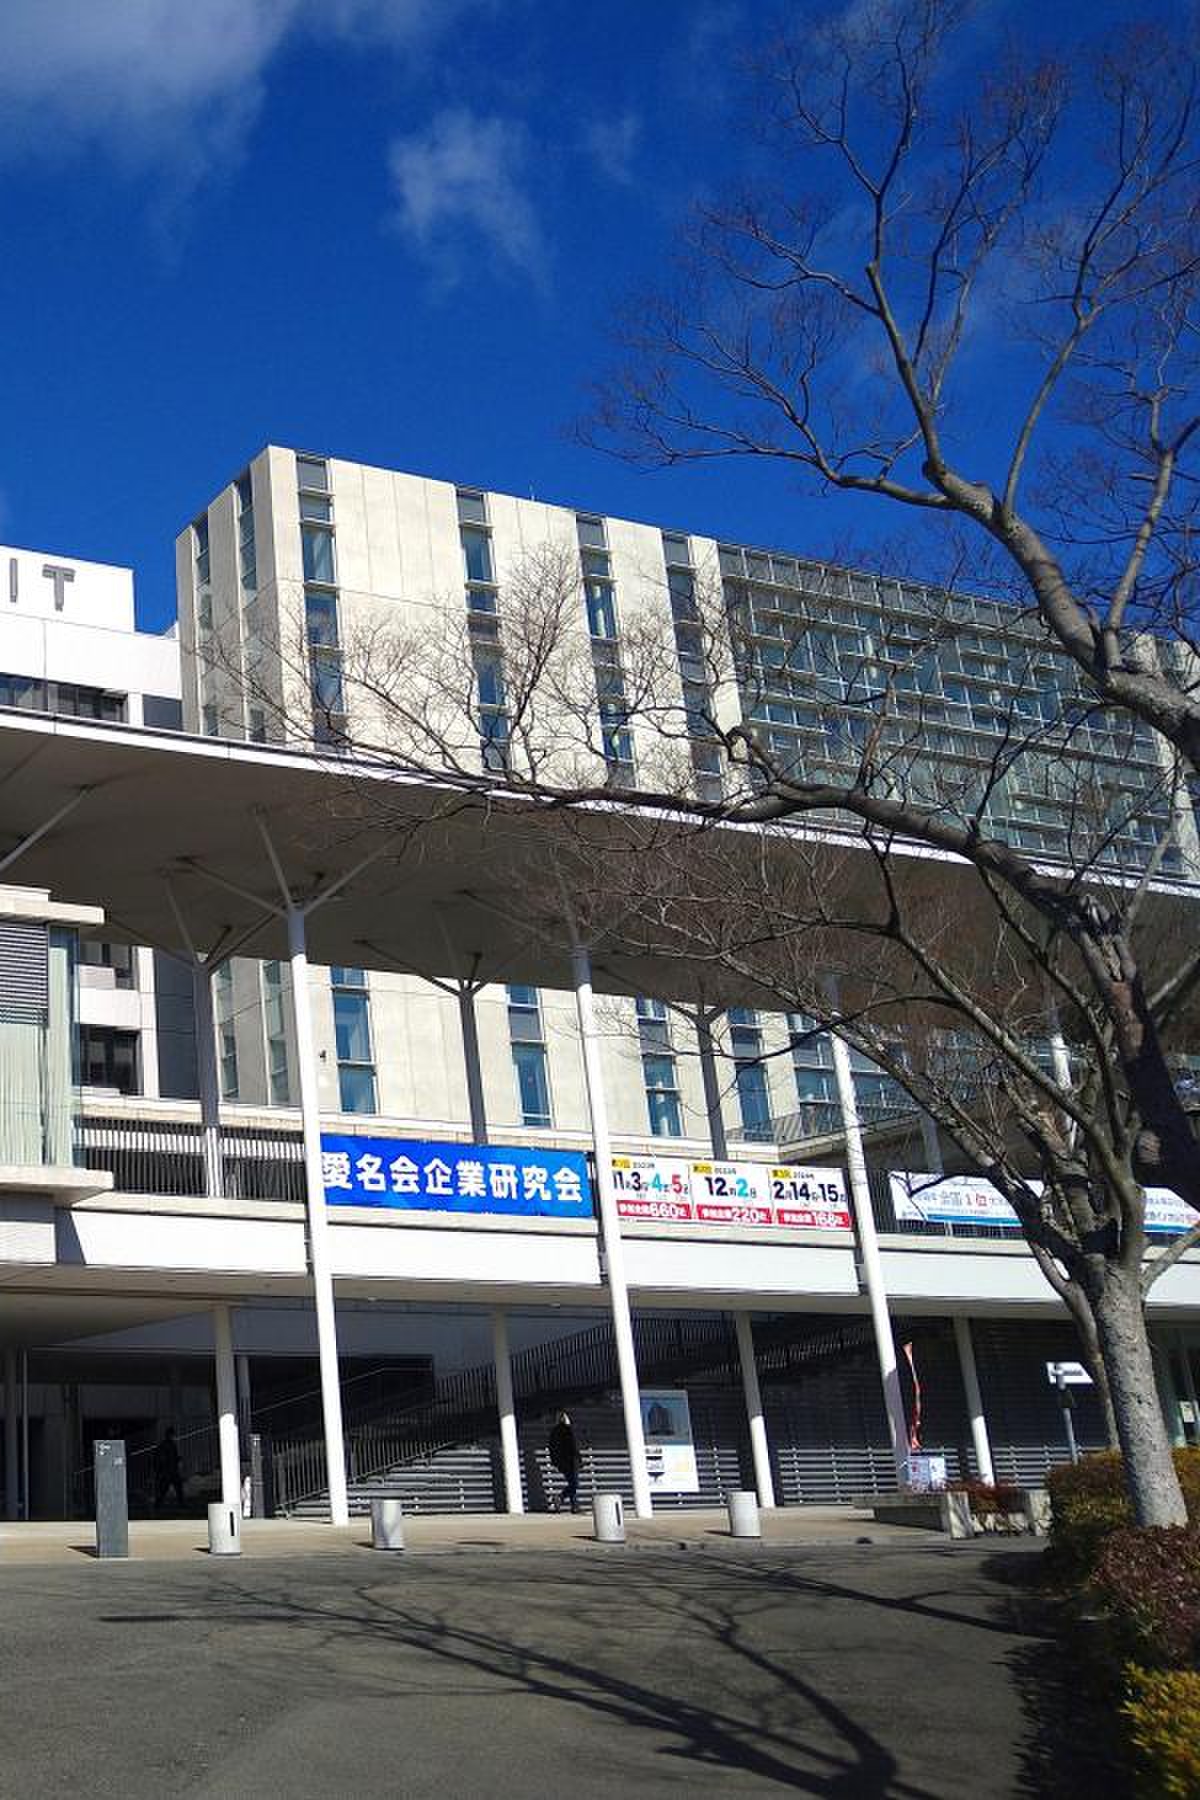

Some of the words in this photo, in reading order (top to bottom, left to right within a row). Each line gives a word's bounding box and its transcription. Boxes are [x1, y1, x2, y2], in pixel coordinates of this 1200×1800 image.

[321, 1152, 582, 1202] 愛名会企業研究会
